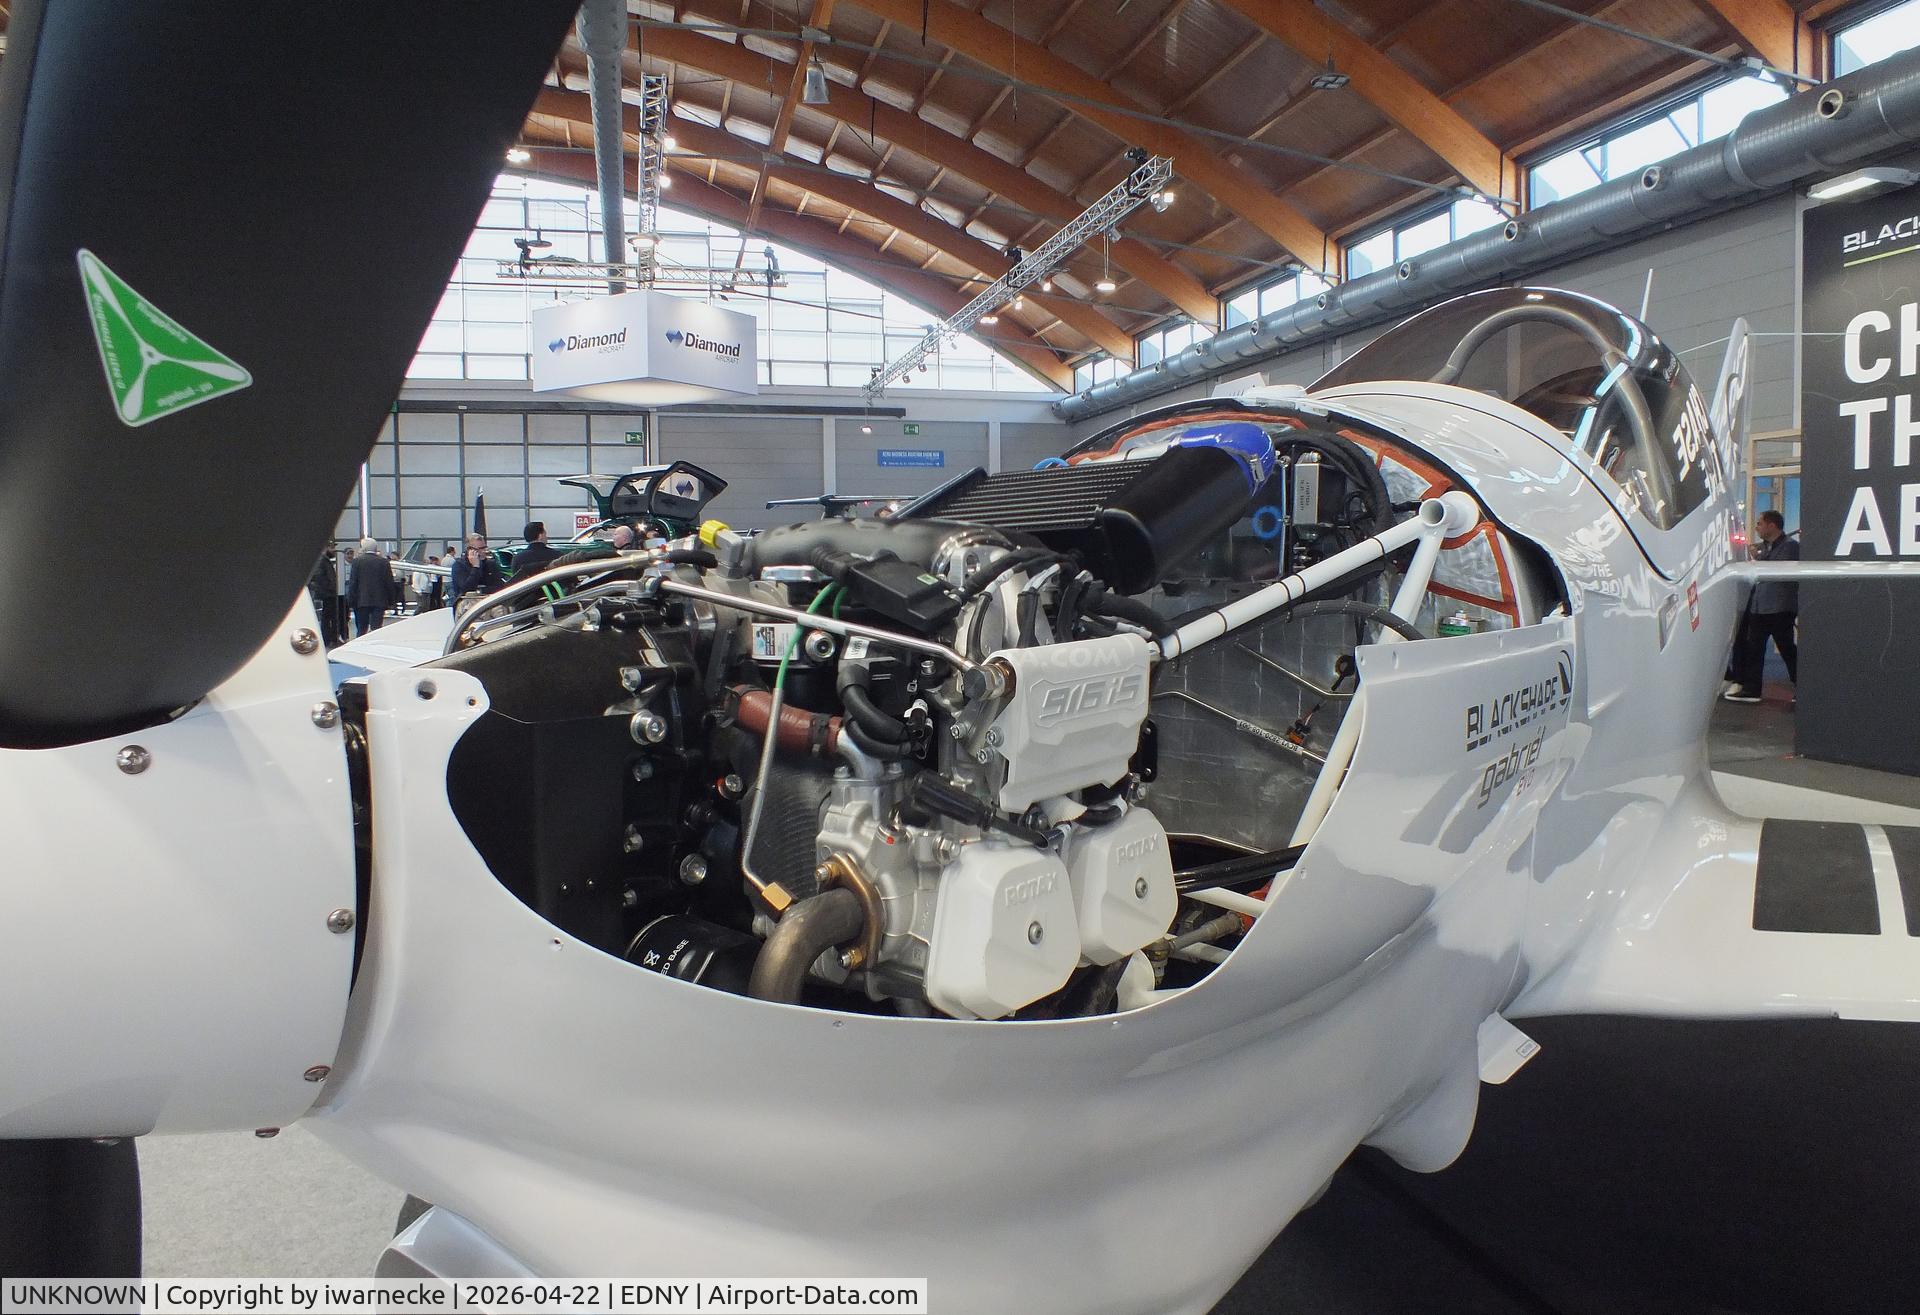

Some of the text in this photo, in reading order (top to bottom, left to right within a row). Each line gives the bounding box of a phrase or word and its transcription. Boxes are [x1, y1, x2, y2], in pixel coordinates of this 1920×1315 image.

[566, 327, 627, 352] Diamond
[685, 332, 741, 357] Diamond
[1477, 725, 1547, 810] gabriel
[1116, 832, 1159, 865] ROTAX
[1004, 871, 1059, 907] ROTAX
[668, 938, 690, 961] BASE
